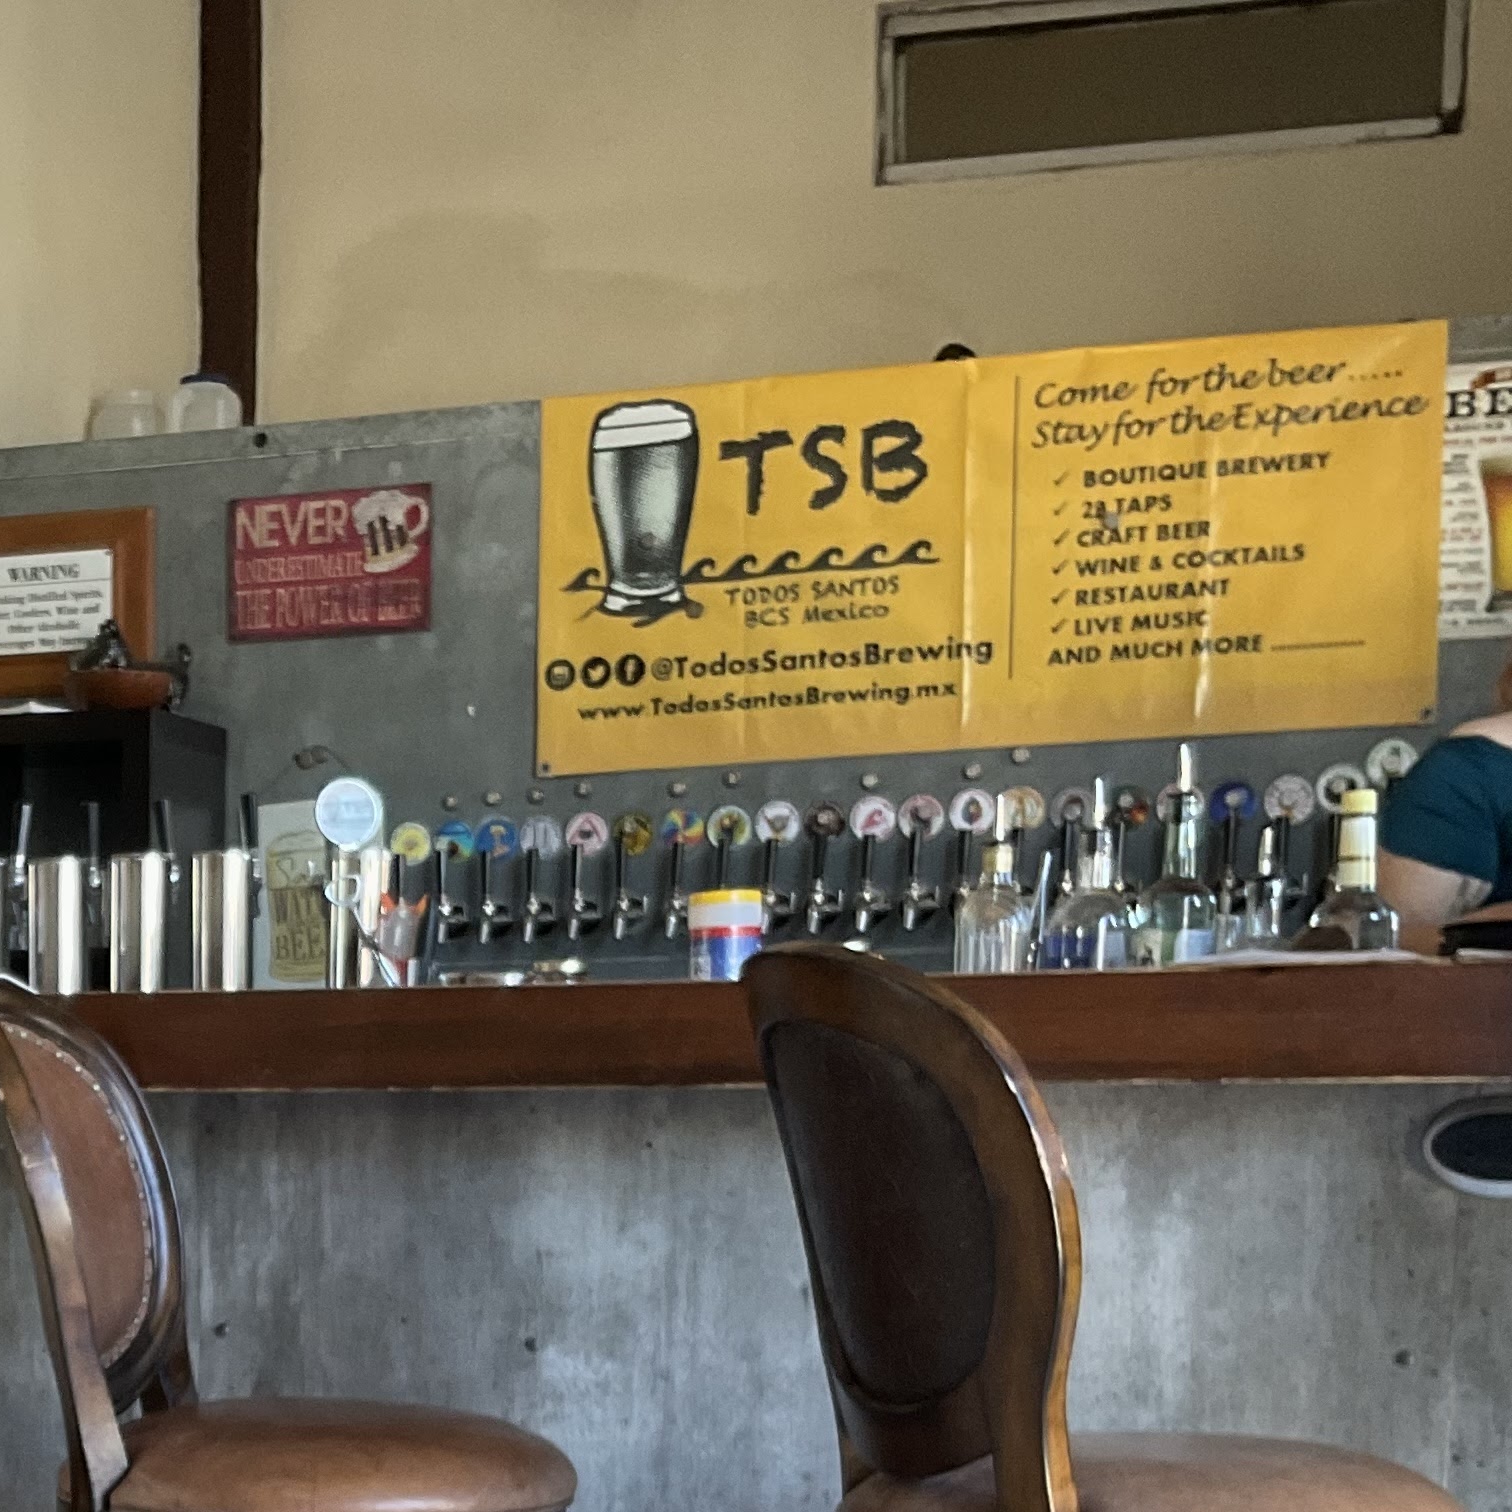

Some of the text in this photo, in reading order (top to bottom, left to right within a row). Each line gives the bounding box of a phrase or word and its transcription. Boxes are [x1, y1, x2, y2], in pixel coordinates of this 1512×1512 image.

[1034, 379, 1139, 411] Come
[1031, 417, 1108, 451] Stay
[1233, 391, 1429, 437] Experience
[718, 419, 929, 516] TSB
[1082, 451, 1332, 488] BOUTIQUE BREWERY
[1114, 494, 1173, 517] TAPS
[235, 499, 349, 550] NEVER
[1077, 520, 1211, 549] CRAFT BEER
[7, 563, 80, 583] WARNING
[1075, 543, 1306, 578] WINE & COCKTAILS
[725, 574, 901, 607] TODOS SANTOS
[1074, 578, 1232, 608] RESTAURANT
[745, 601, 891, 629] BCS Mexico
[1074, 609, 1209, 637] LIVE MUSIC
[651, 635, 994, 683] @TodosSantosBrewing
[1048, 634, 1264, 666] AND MUCH MORE
[578, 680, 958, 721] www.TodosSantosBrewing.mx
